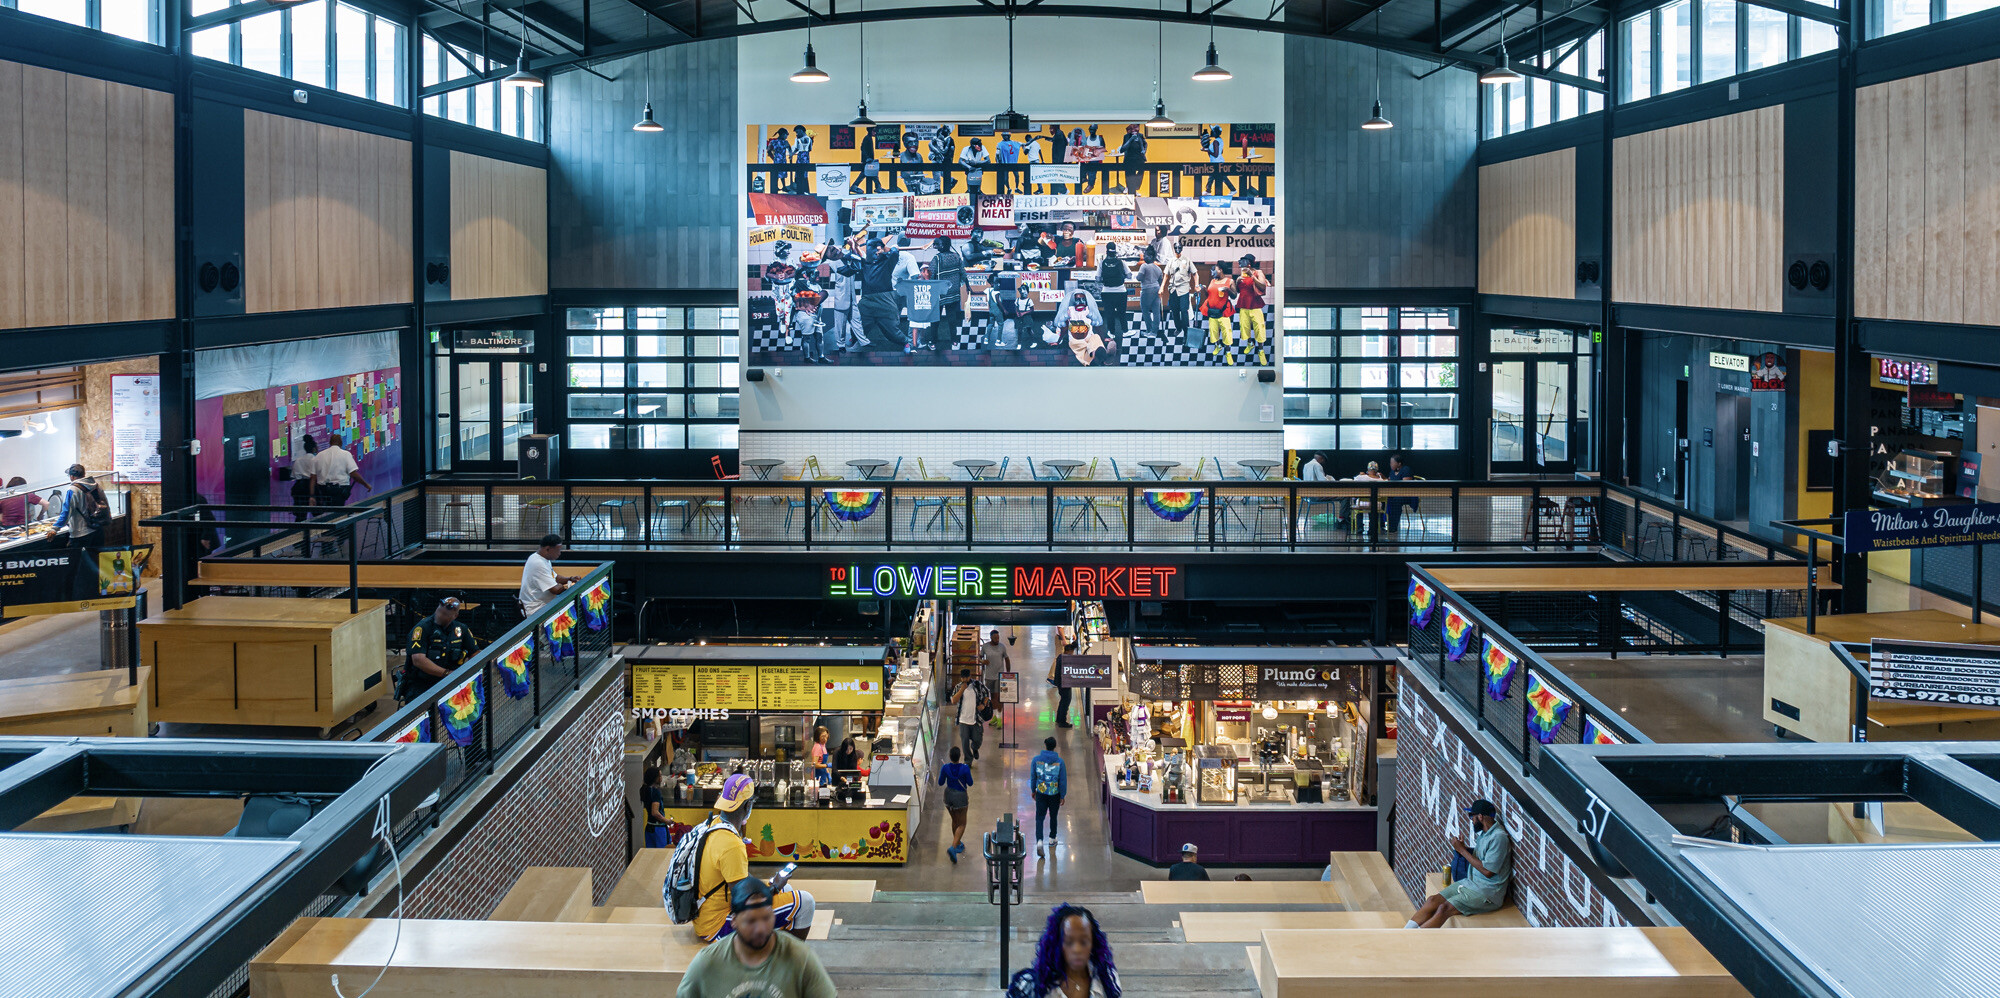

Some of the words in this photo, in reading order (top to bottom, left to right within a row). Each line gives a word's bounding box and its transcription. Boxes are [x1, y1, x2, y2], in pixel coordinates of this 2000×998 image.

[1182, 163, 1215, 175] Thanks
[1218, 163, 1232, 174] For
[1031, 173, 1059, 182] LEXINGTON
[1060, 173, 1080, 182] MARKET
[914, 198, 936, 209] Chicken
[943, 196, 955, 206] Fish
[957, 195, 968, 206] Sub
[981, 199, 1012, 208] CRAB
[1015, 195, 1059, 208] FRIED
[1065, 195, 1134, 207] CHICKEN
[764, 214, 824, 225] HAMBURGERS
[930, 211, 956, 220] OYSTERS
[981, 208, 1012, 219] MEAT
[1020, 211, 1049, 221] FISH
[1144, 216, 1173, 225] PARKS
[749, 228, 777, 243] POULTRY
[780, 228, 812, 242] POULTRY
[919, 228, 937, 236] MAWS
[1179, 235, 1221, 248] Garden
[1225, 235, 1275, 248] Produce
[1021, 272, 1052, 281] SNOWBALLS
[913, 284, 932, 292] STOP
[1714, 355, 1745, 368] ELEVATOR
[1721, 383, 1733, 391] LOWER
[1734, 385, 1750, 393] MARKET
[1871, 510, 1929, 532] Milton's
[1873, 537, 1919, 548] Waistbeads
[1921, 535, 1937, 545] And
[1939, 532, 1975, 546] Spiritual
[1976, 530, 2000, 541] Needs
[6, 557, 70, 570] BMORE
[830, 568, 847, 581] TO
[851, 565, 983, 597] LOWER
[1014, 566, 1177, 597] MARKET
[631, 708, 730, 720] SMOOTHIES
[371, 792, 390, 840] 41
[1583, 787, 1611, 843] 37
